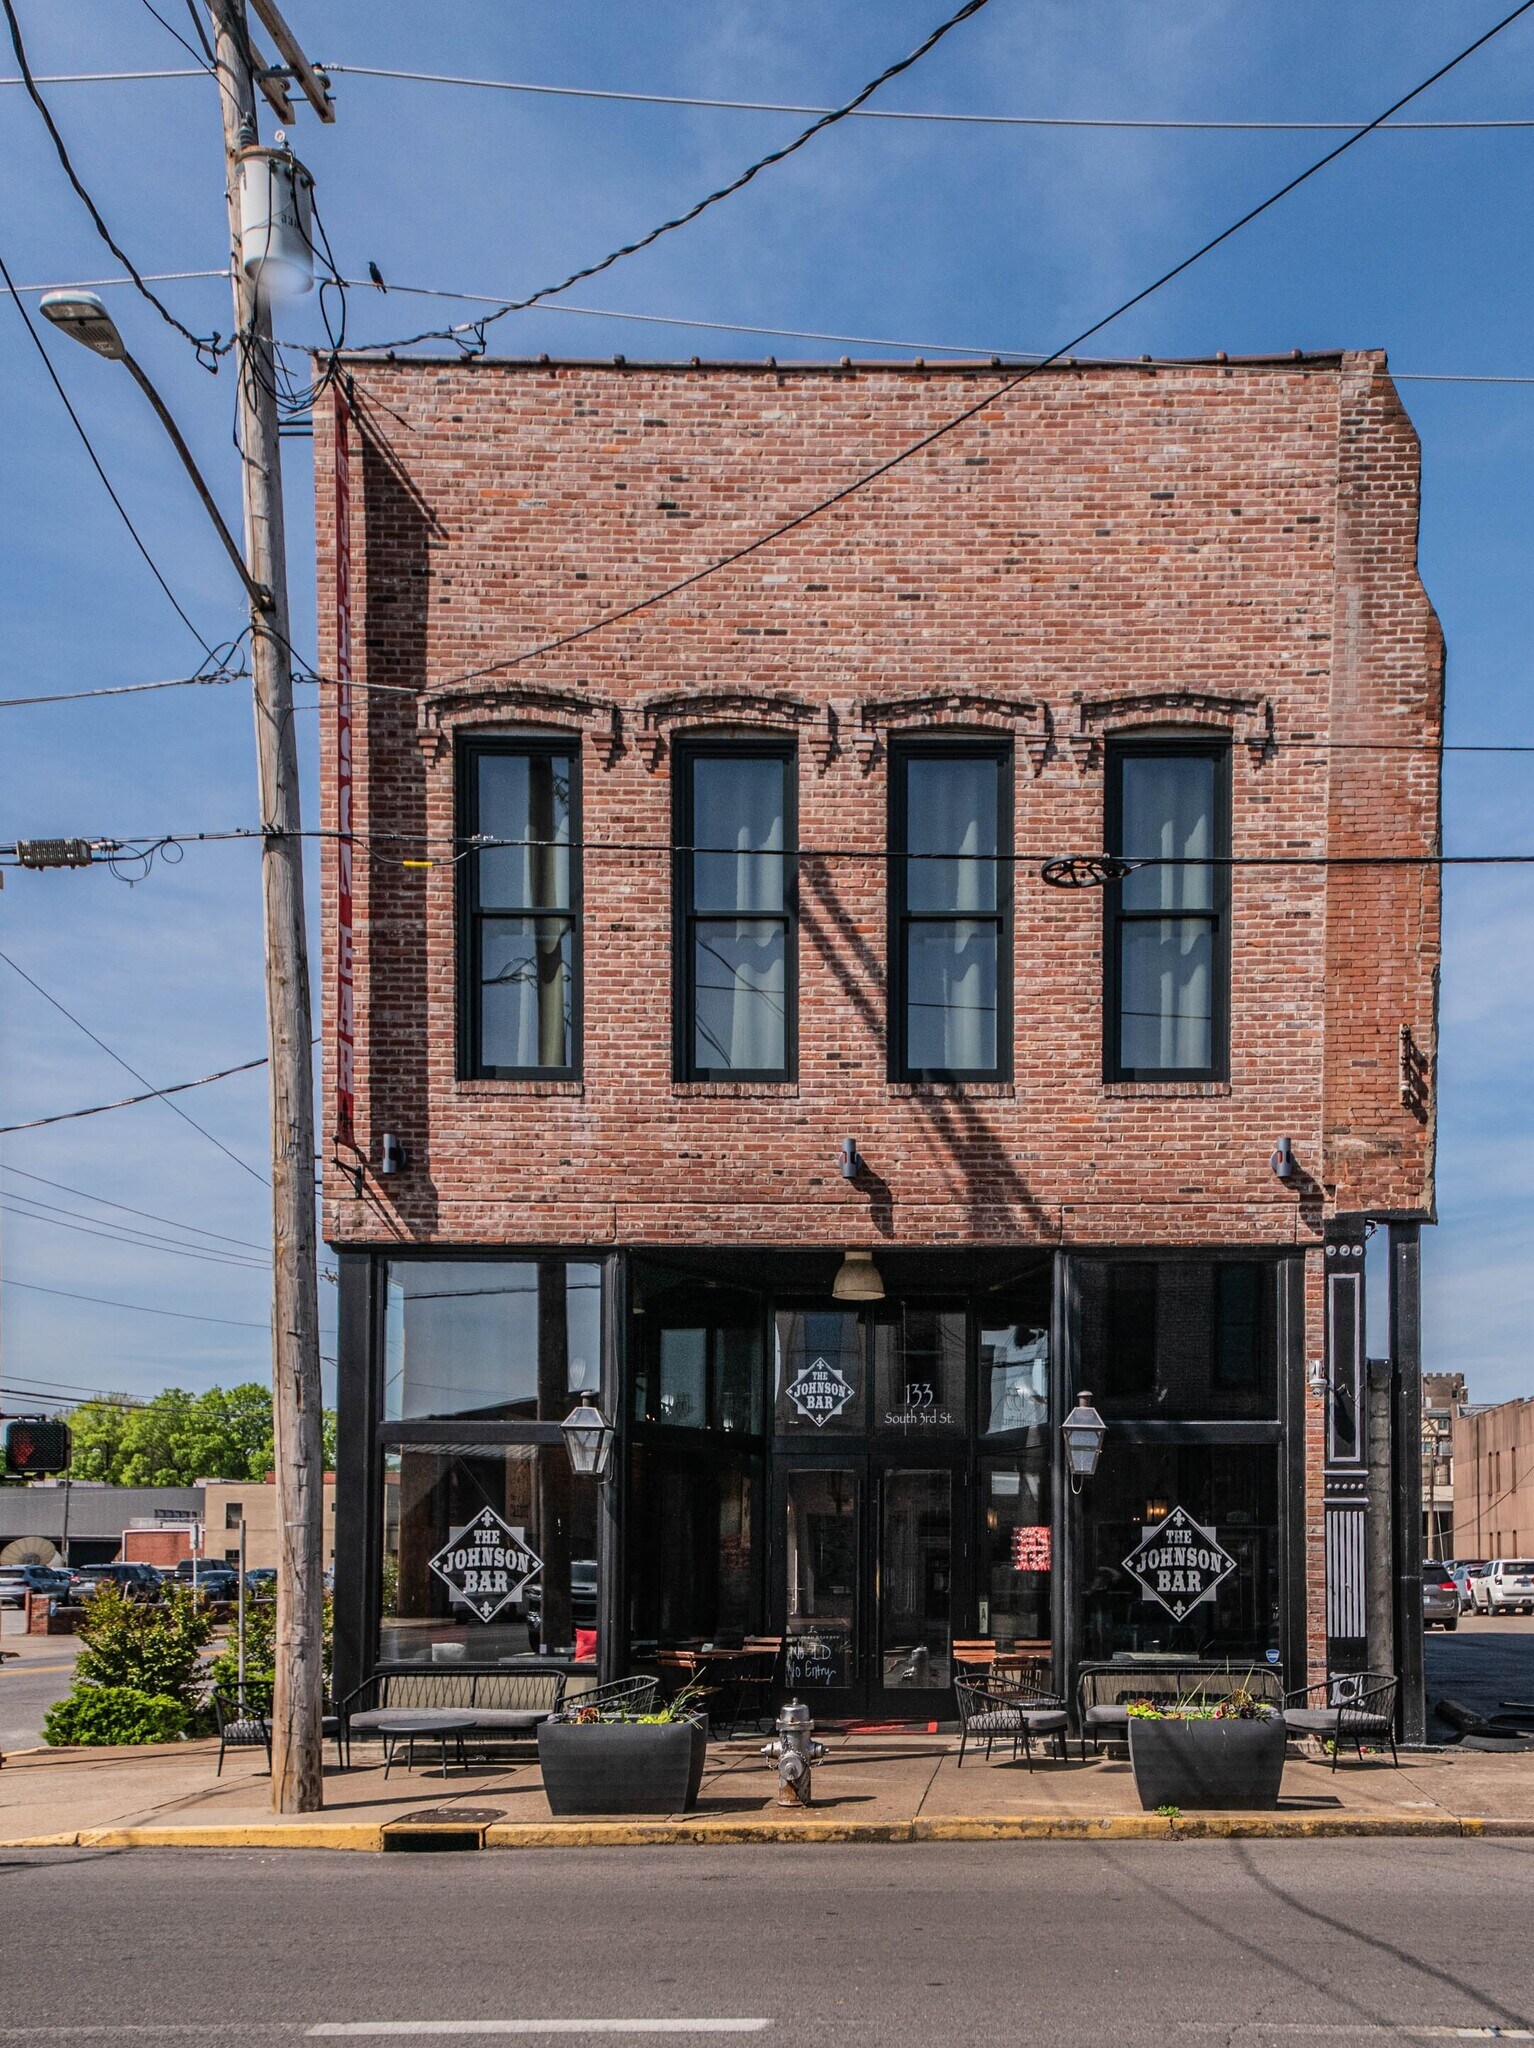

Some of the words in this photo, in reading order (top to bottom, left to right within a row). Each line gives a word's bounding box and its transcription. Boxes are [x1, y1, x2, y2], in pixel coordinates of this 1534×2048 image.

[338, 921, 354, 1094] BAR
[812, 1371, 828, 1380] THE
[793, 1381, 846, 1398] JOHNSON
[906, 1383, 933, 1408] 133
[806, 1395, 833, 1409] BAR
[884, 1408, 917, 1424] South
[919, 1408, 937, 1426] 3rd
[938, 1411, 955, 1424] St.
[473, 1529, 500, 1545] THE
[1166, 1529, 1192, 1544] THE
[442, 1547, 530, 1574] JOHNSON
[1136, 1546, 1222, 1574] JOHNSON
[463, 1570, 508, 1593] BAR
[1157, 1570, 1201, 1592] BAR
[787, 1661, 801, 1678] No
